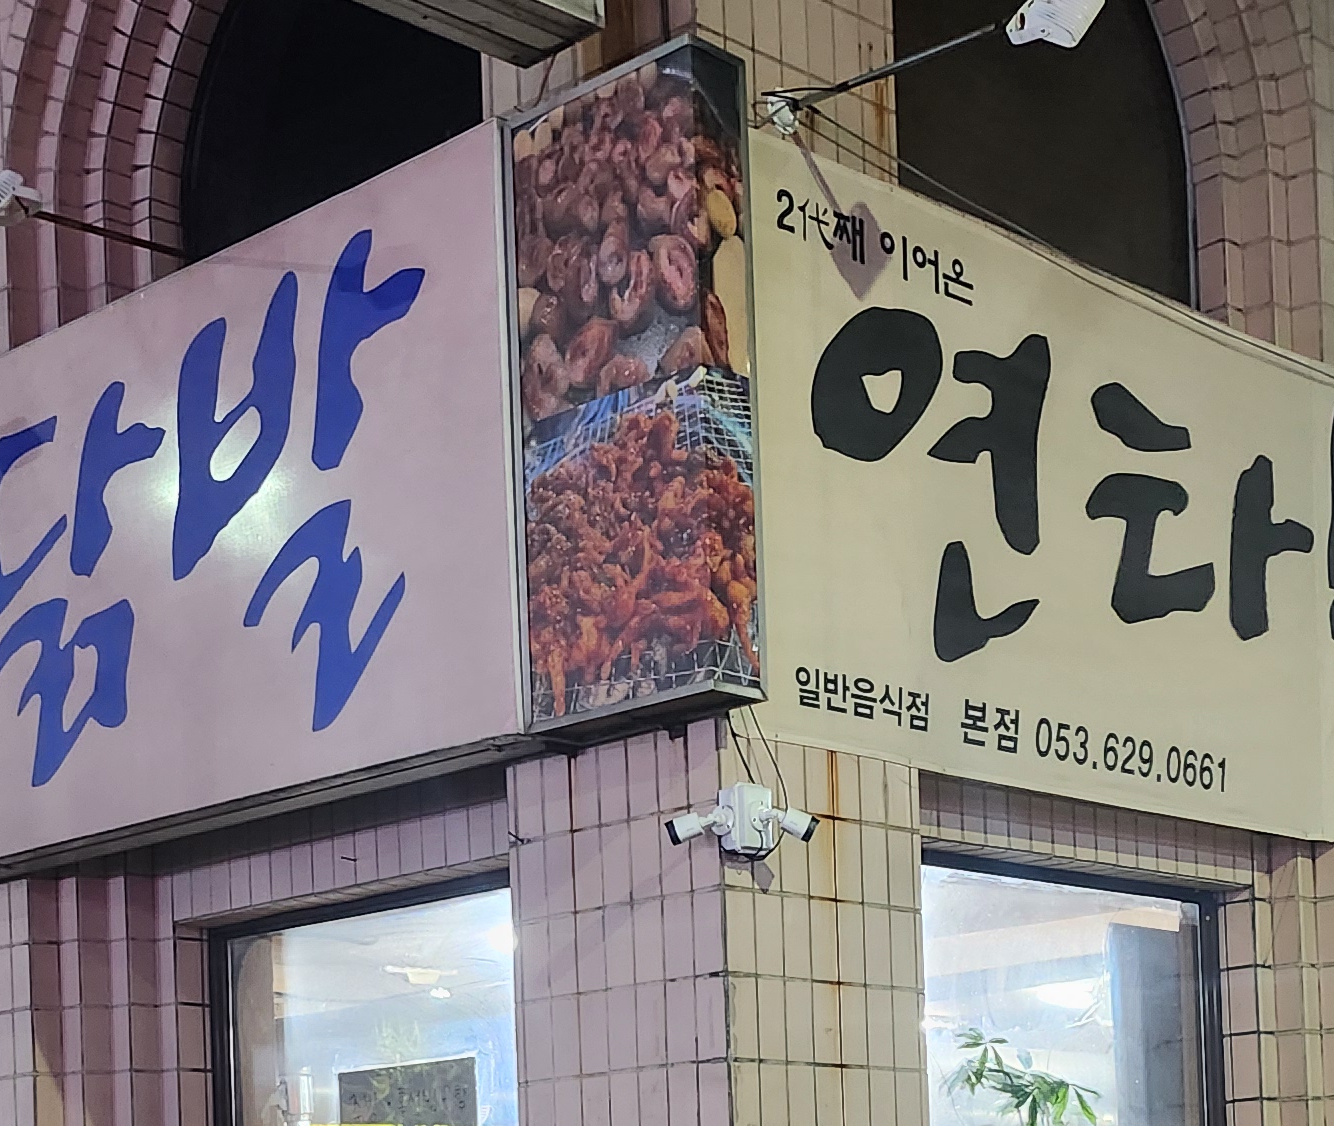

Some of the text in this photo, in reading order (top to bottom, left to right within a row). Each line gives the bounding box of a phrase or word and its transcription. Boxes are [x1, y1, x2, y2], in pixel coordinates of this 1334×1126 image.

[881, 232, 974, 306] 이어온
[795, 666, 1229, 793] 일반음식점 본점 053.629.0661
